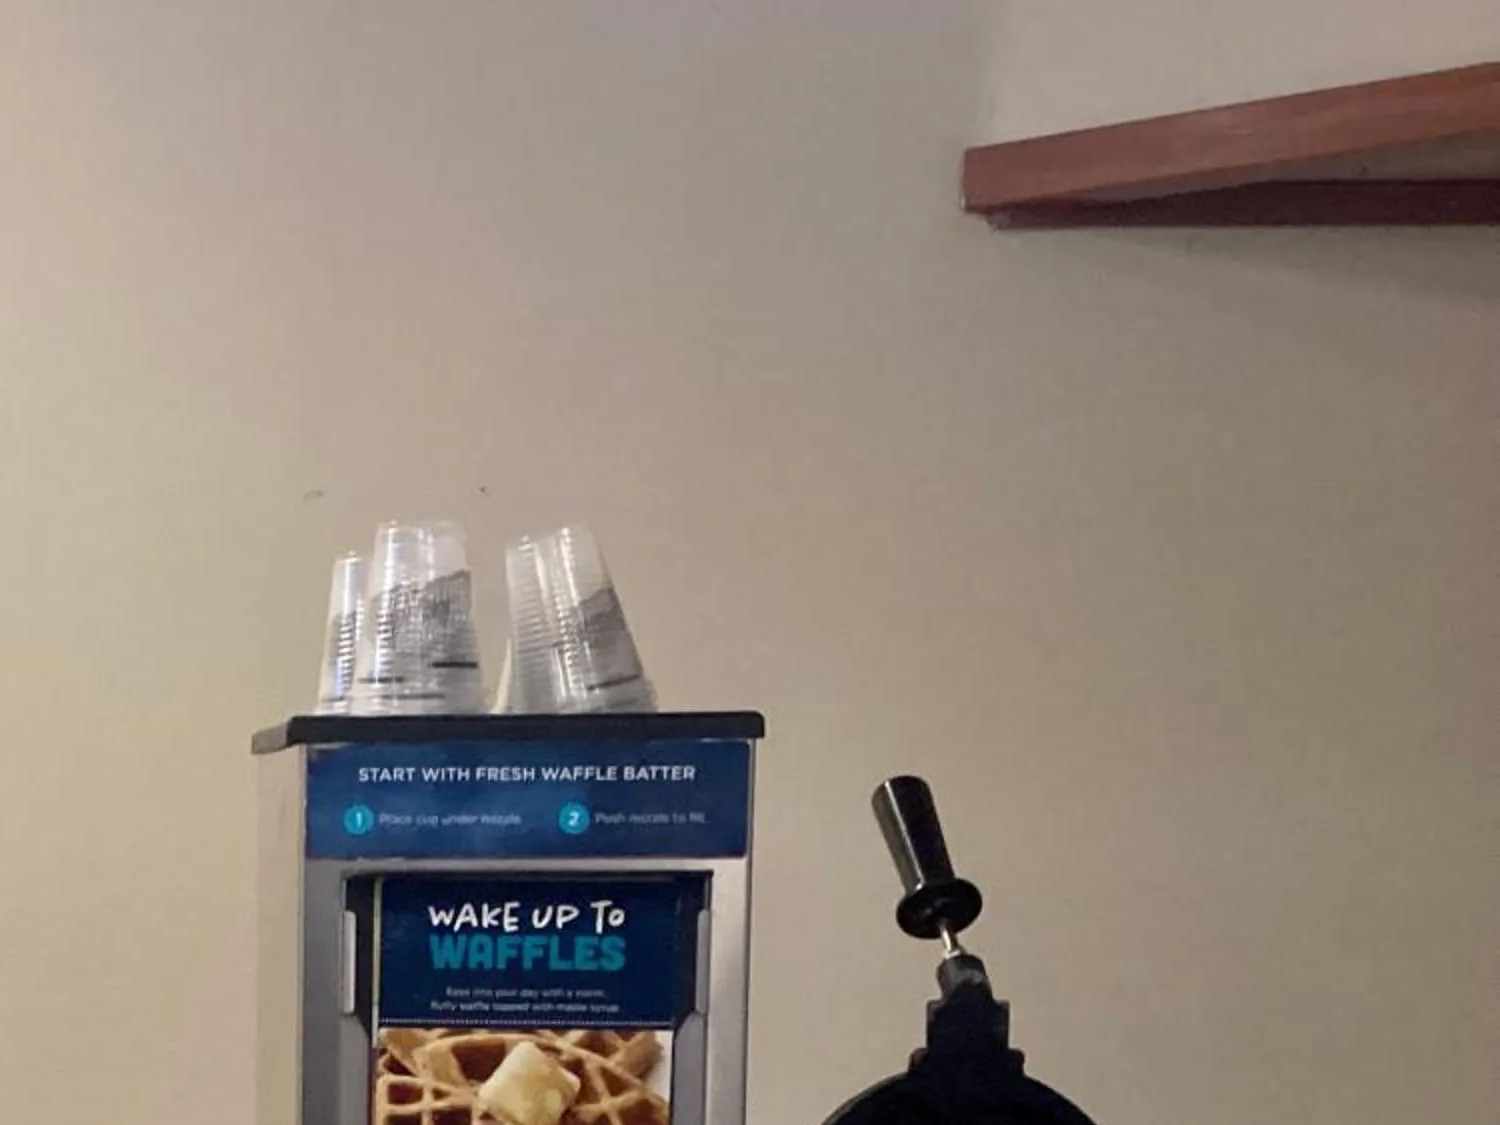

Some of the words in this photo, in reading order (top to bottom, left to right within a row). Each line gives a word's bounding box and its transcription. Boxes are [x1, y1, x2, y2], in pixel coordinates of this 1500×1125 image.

[358, 767, 415, 782] START
[421, 767, 470, 782] WITH
[475, 766, 535, 782] FRESH
[541, 766, 617, 781] WAFFLE
[623, 765, 696, 781] BATTER
[428, 901, 520, 932] WAKE
[531, 905, 580, 929] UP
[429, 934, 626, 972] WAFFLES
